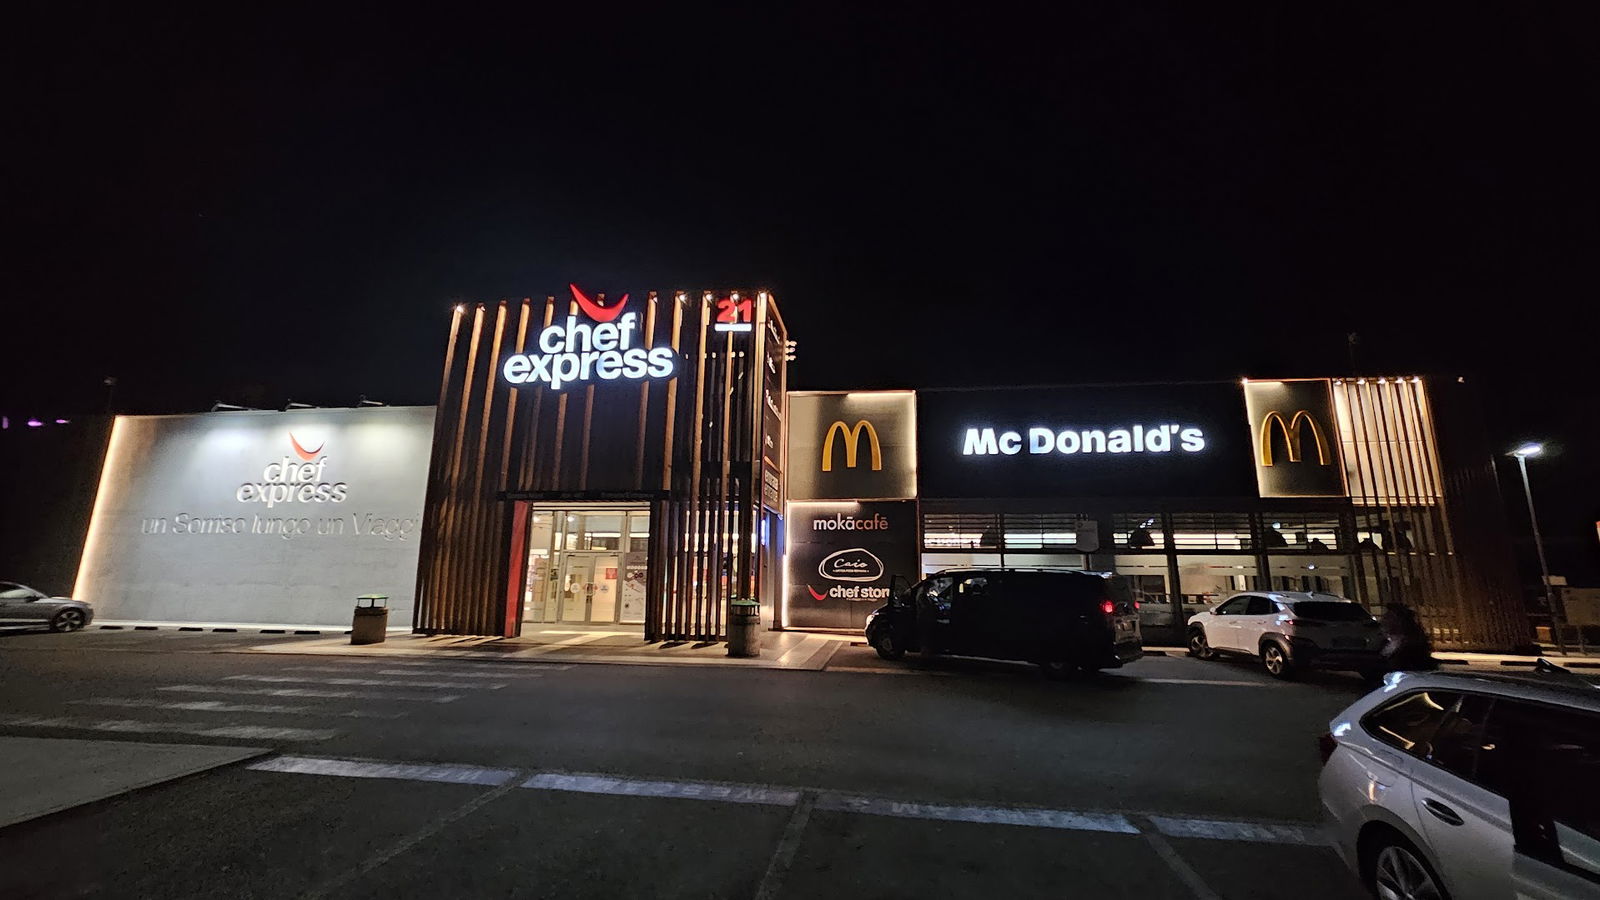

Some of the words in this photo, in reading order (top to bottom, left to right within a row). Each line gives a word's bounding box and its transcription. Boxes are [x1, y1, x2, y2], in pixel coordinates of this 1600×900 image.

[715, 299, 752, 323] 21
[539, 312, 636, 354] chef
[503, 347, 674, 390] express
[962, 427, 1022, 455] Mc
[1029, 424, 1205, 455] Donald's
[263, 456, 328, 483] chef
[236, 481, 348, 508] express
[141, 516, 168, 535] un
[251, 513, 310, 540] lungo
[317, 515, 344, 535] un
[352, 512, 420, 541] Viaggi
[829, 585, 860, 598] chef
